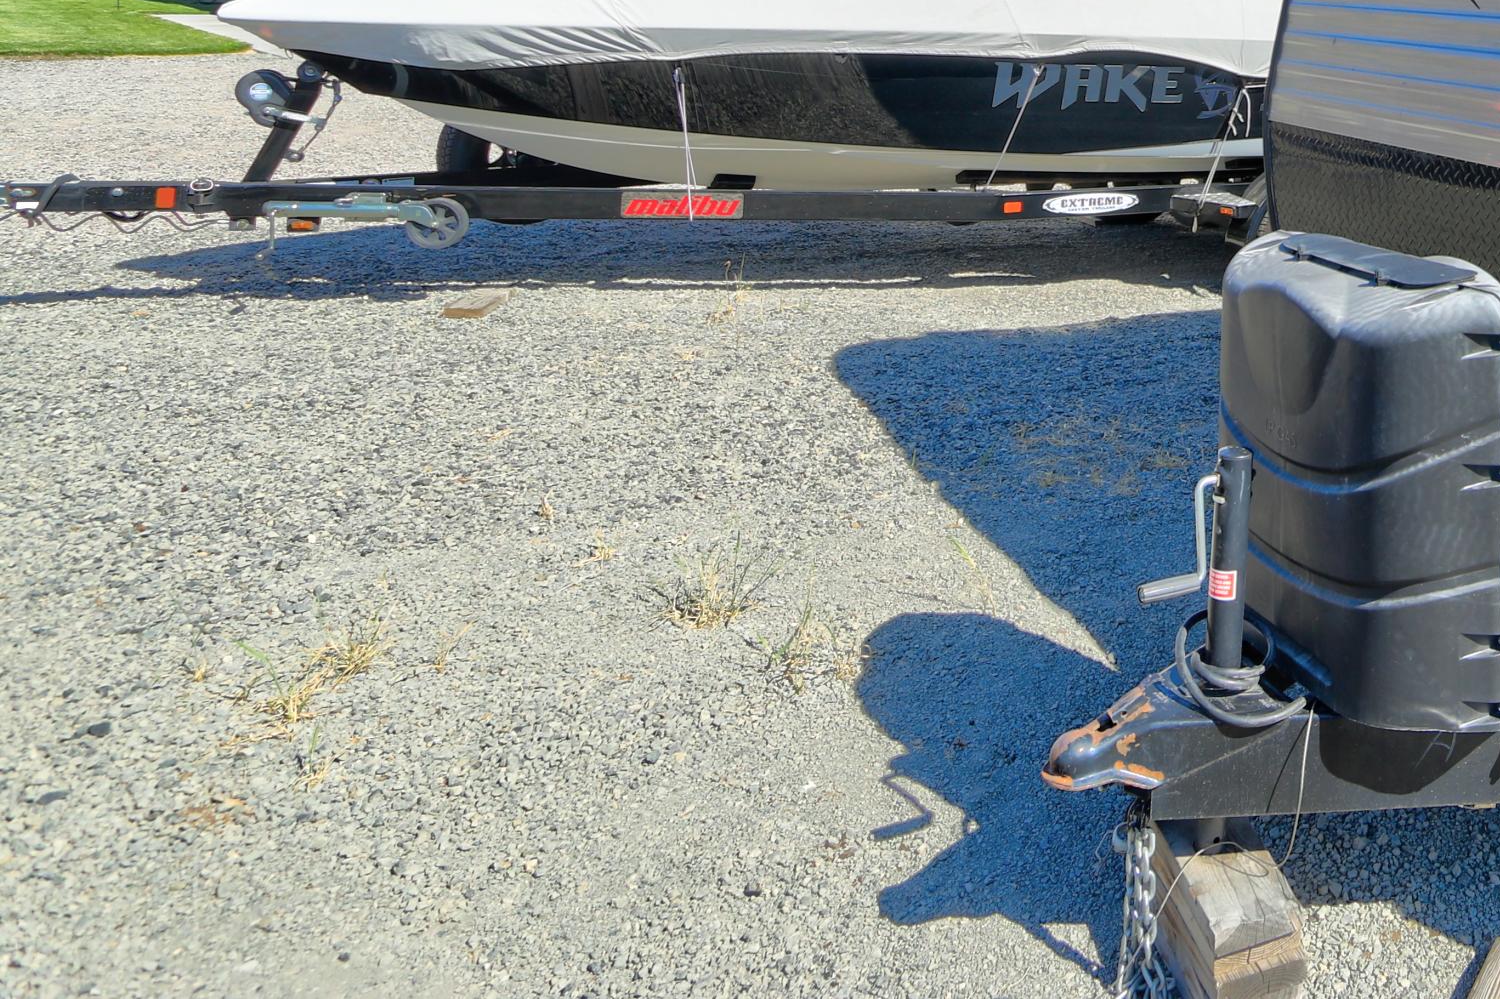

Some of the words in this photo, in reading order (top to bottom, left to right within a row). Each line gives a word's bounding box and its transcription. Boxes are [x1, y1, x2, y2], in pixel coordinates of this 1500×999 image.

[991, 62, 1185, 112] WAKE
[623, 194, 742, 217] malibu
[1060, 197, 1123, 208] EXTREME
